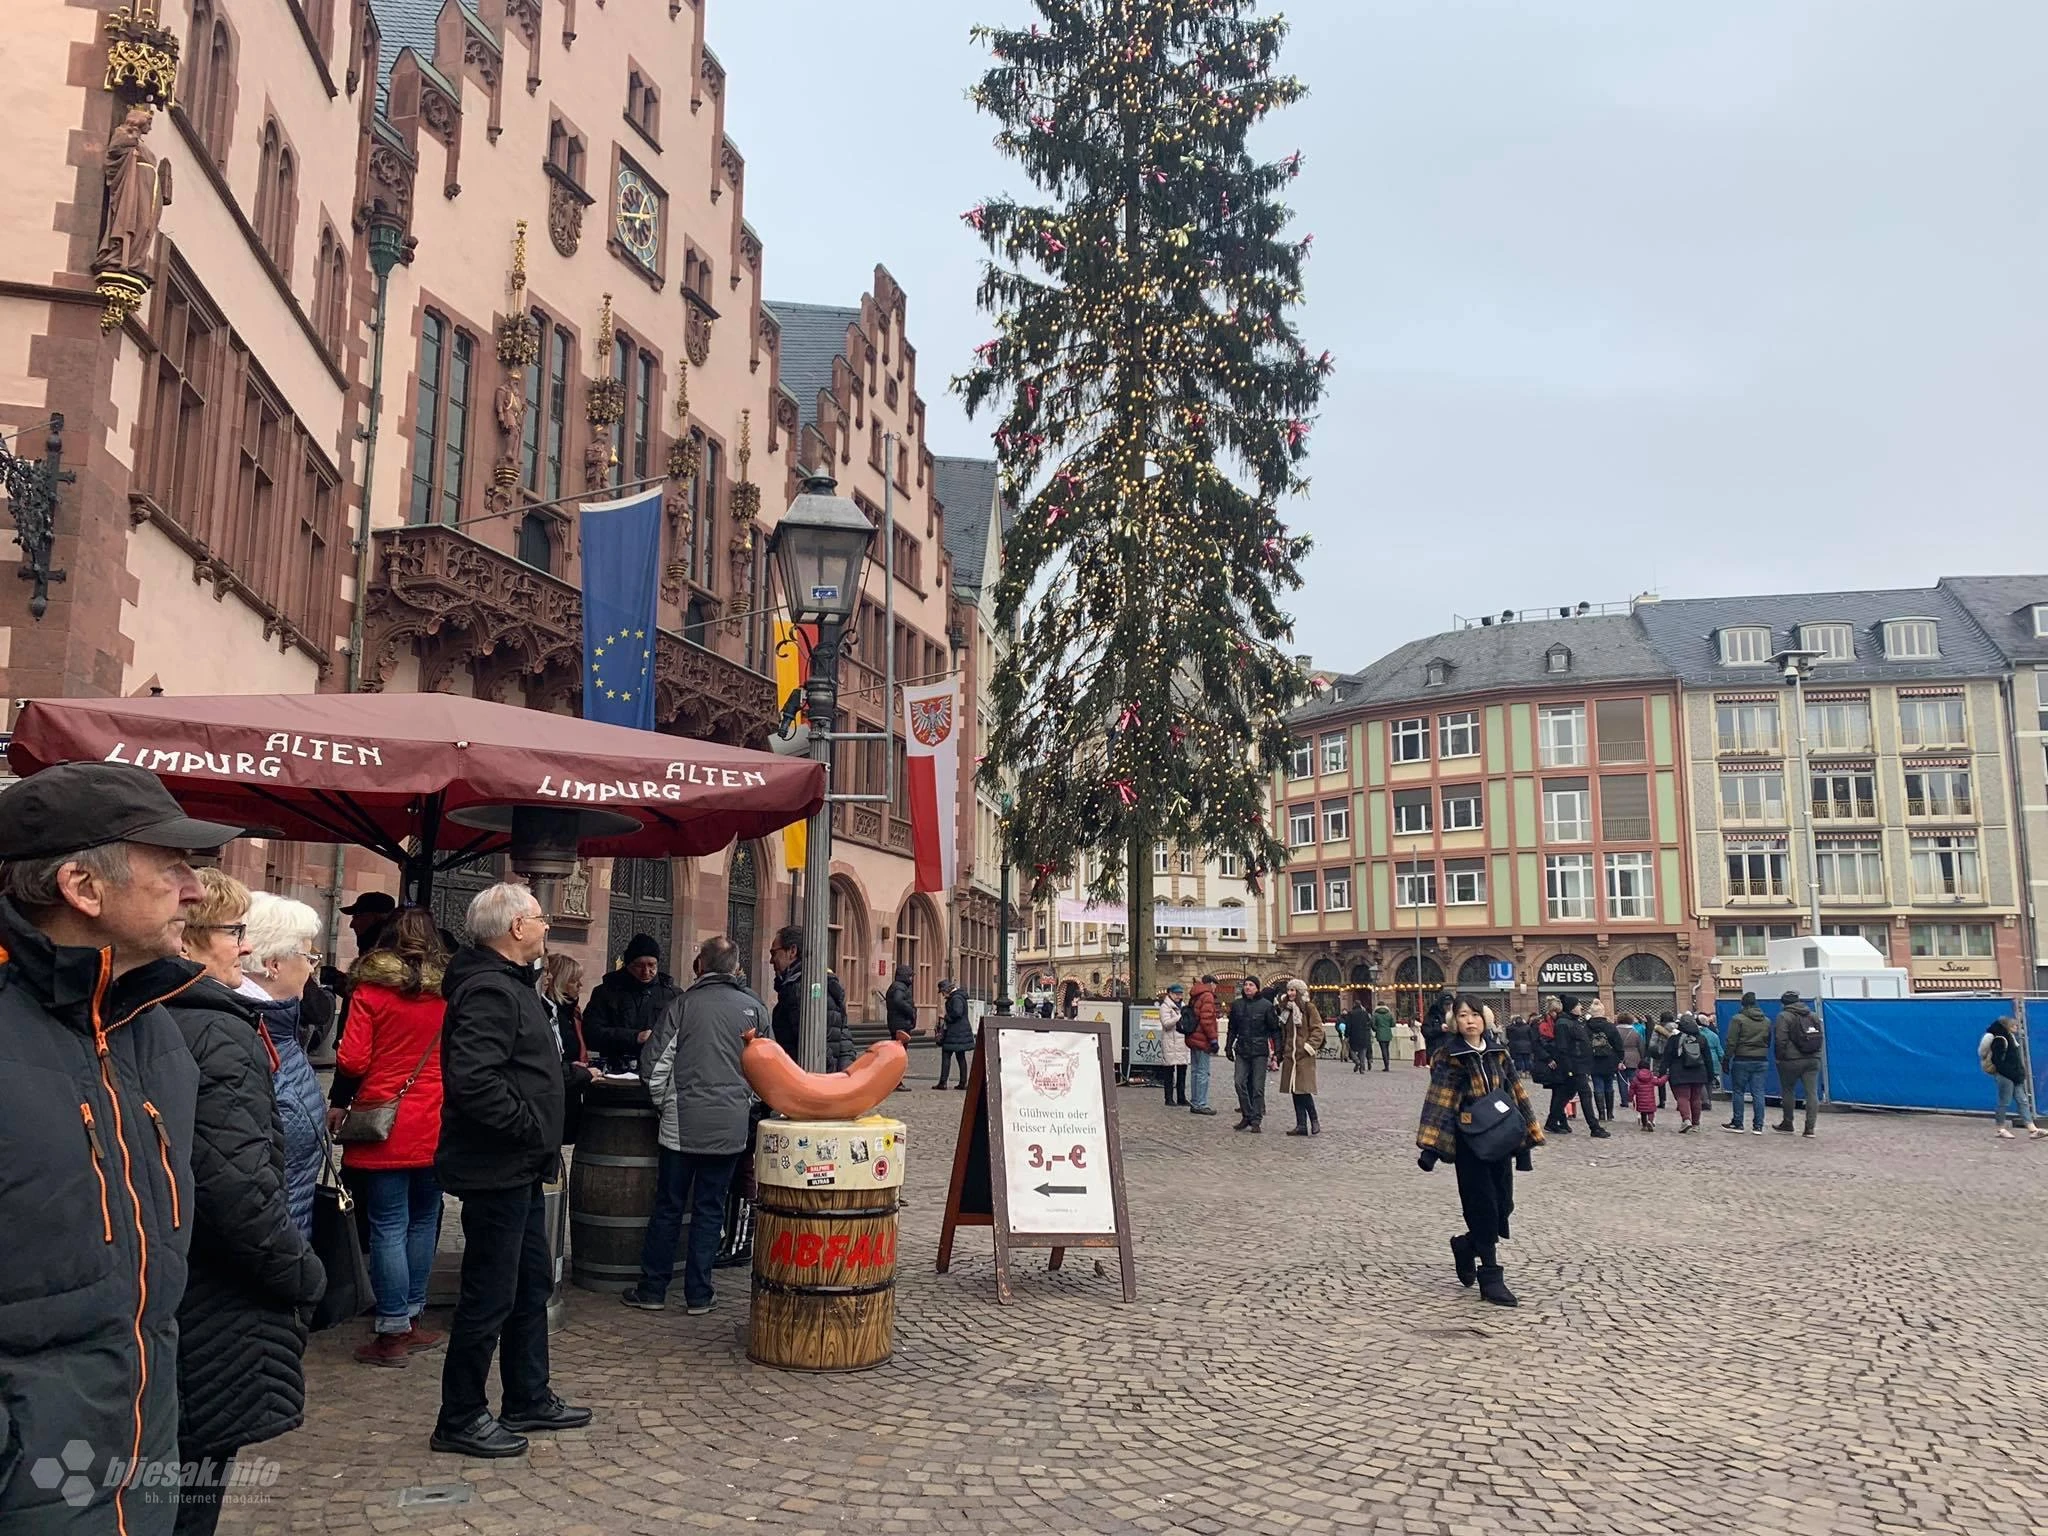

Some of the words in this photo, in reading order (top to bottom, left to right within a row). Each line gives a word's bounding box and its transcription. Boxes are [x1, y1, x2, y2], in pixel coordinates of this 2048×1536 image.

[264, 732, 383, 766] ALTEN
[104, 742, 282, 777] LIMPURG
[665, 762, 767, 787] ALTEN
[537, 775, 681, 801] LIMPURG
[1497, 963, 1513, 979] U
[1546, 963, 1587, 971] BRILLEN
[1541, 972, 1594, 983] WEISS
[1019, 1107, 1064, 1119] Glühwein
[1067, 1109, 1088, 1120] oder
[1012, 1122, 1046, 1133] Heisser
[1049, 1123, 1097, 1136] Apfelwein
